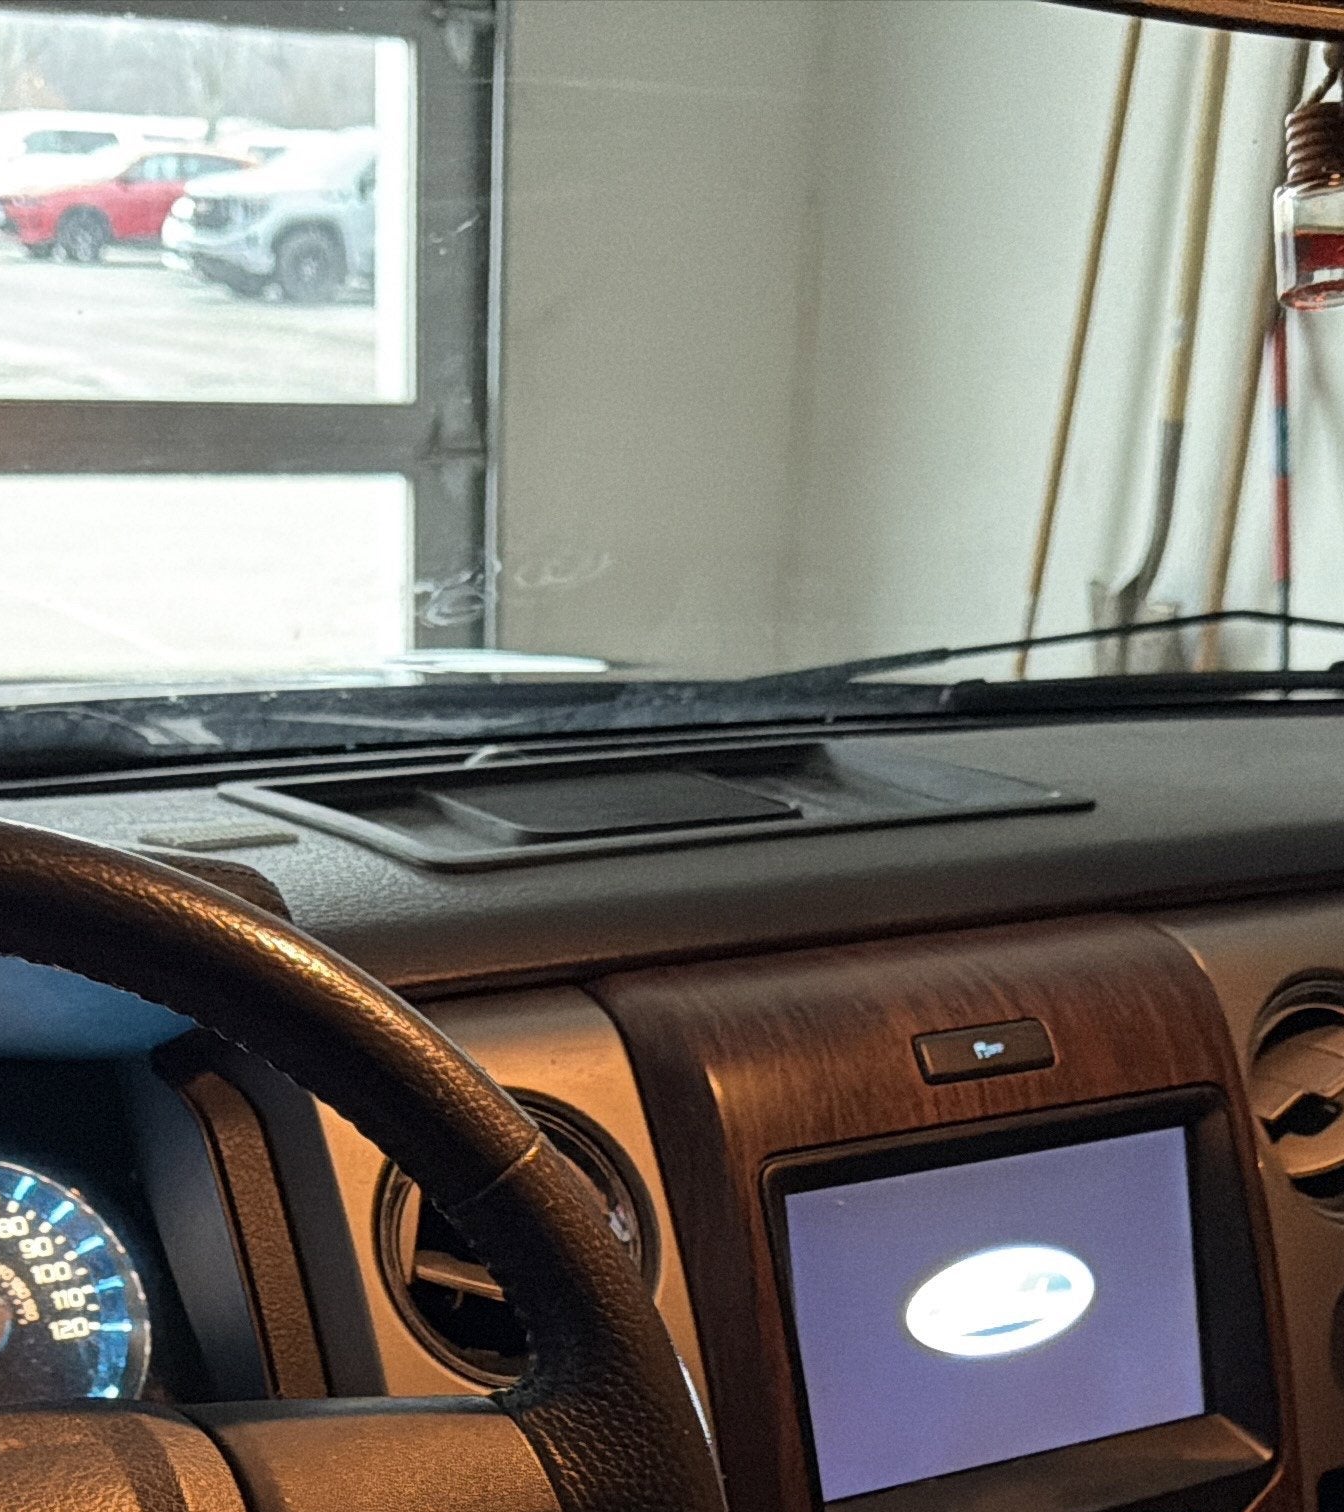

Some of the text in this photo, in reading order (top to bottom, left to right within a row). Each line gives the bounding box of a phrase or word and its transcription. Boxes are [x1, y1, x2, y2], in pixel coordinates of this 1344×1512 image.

[19, 1236, 54, 1259] 90
[31, 1261, 72, 1284] 100
[50, 1287, 86, 1310] 110
[48, 1317, 89, 1340] 120
